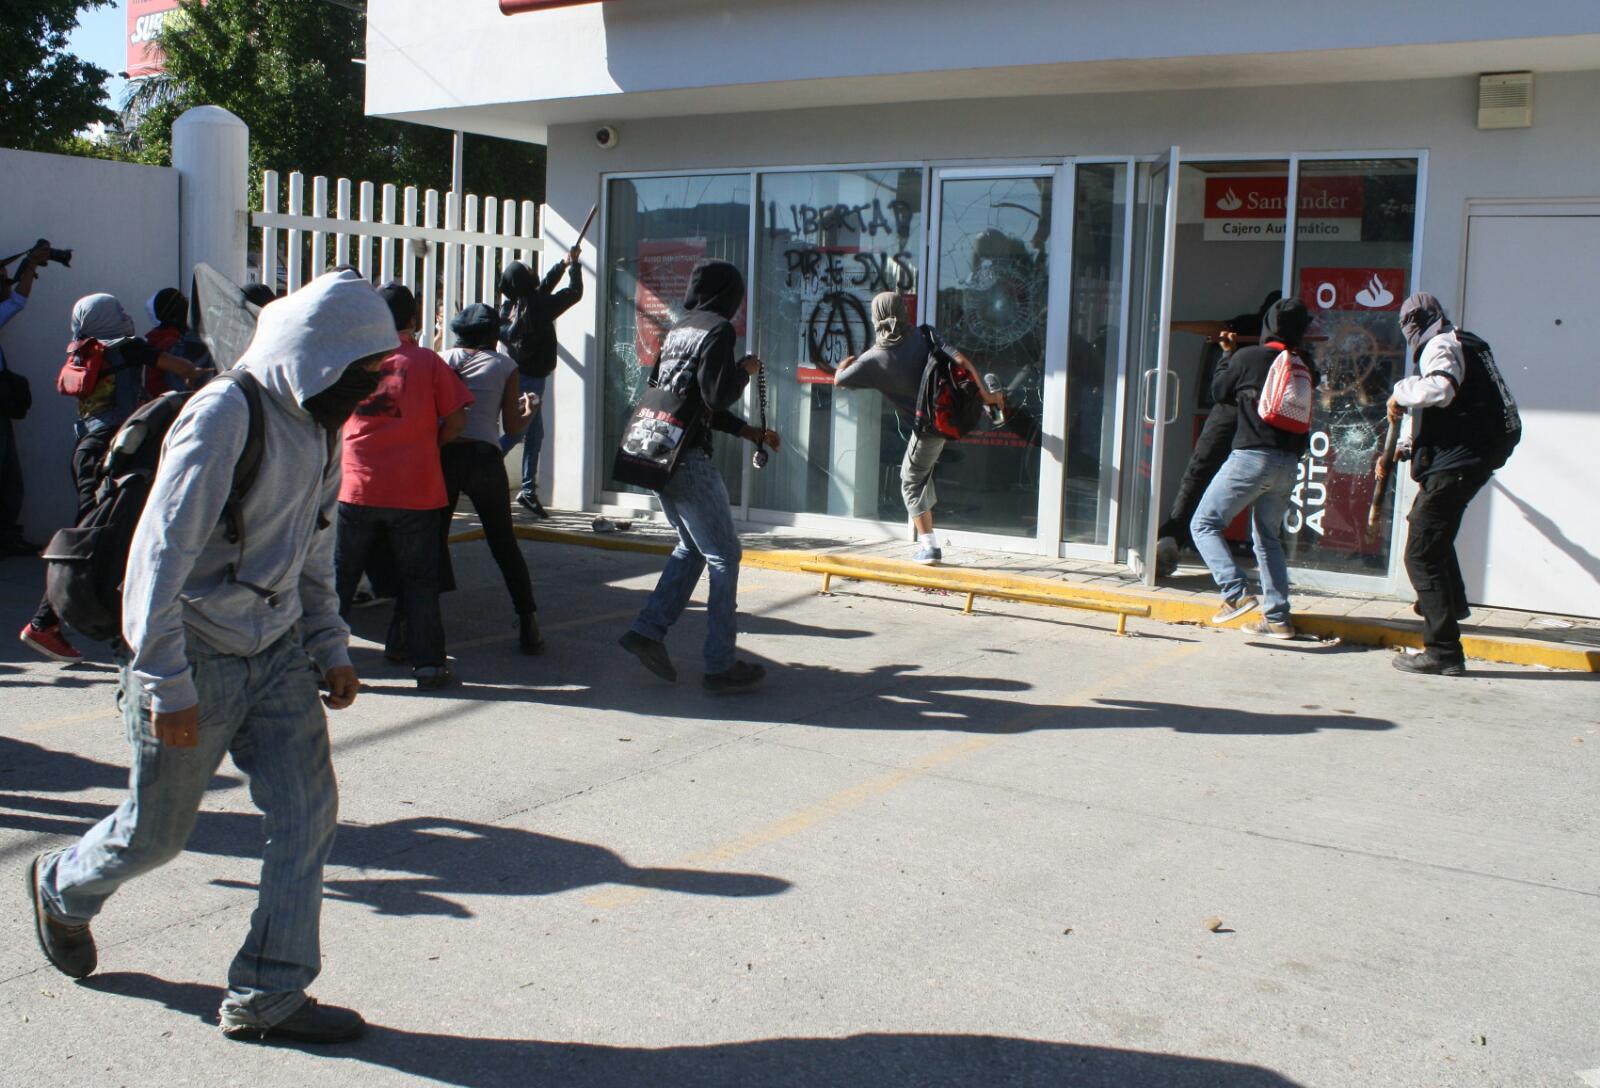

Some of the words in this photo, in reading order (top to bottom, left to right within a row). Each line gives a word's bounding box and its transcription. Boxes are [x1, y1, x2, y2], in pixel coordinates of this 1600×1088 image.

[1247, 190, 1349, 209] Santnder
[1222, 222, 1261, 236] Cajero
[1265, 222, 1340, 235] Autmático
